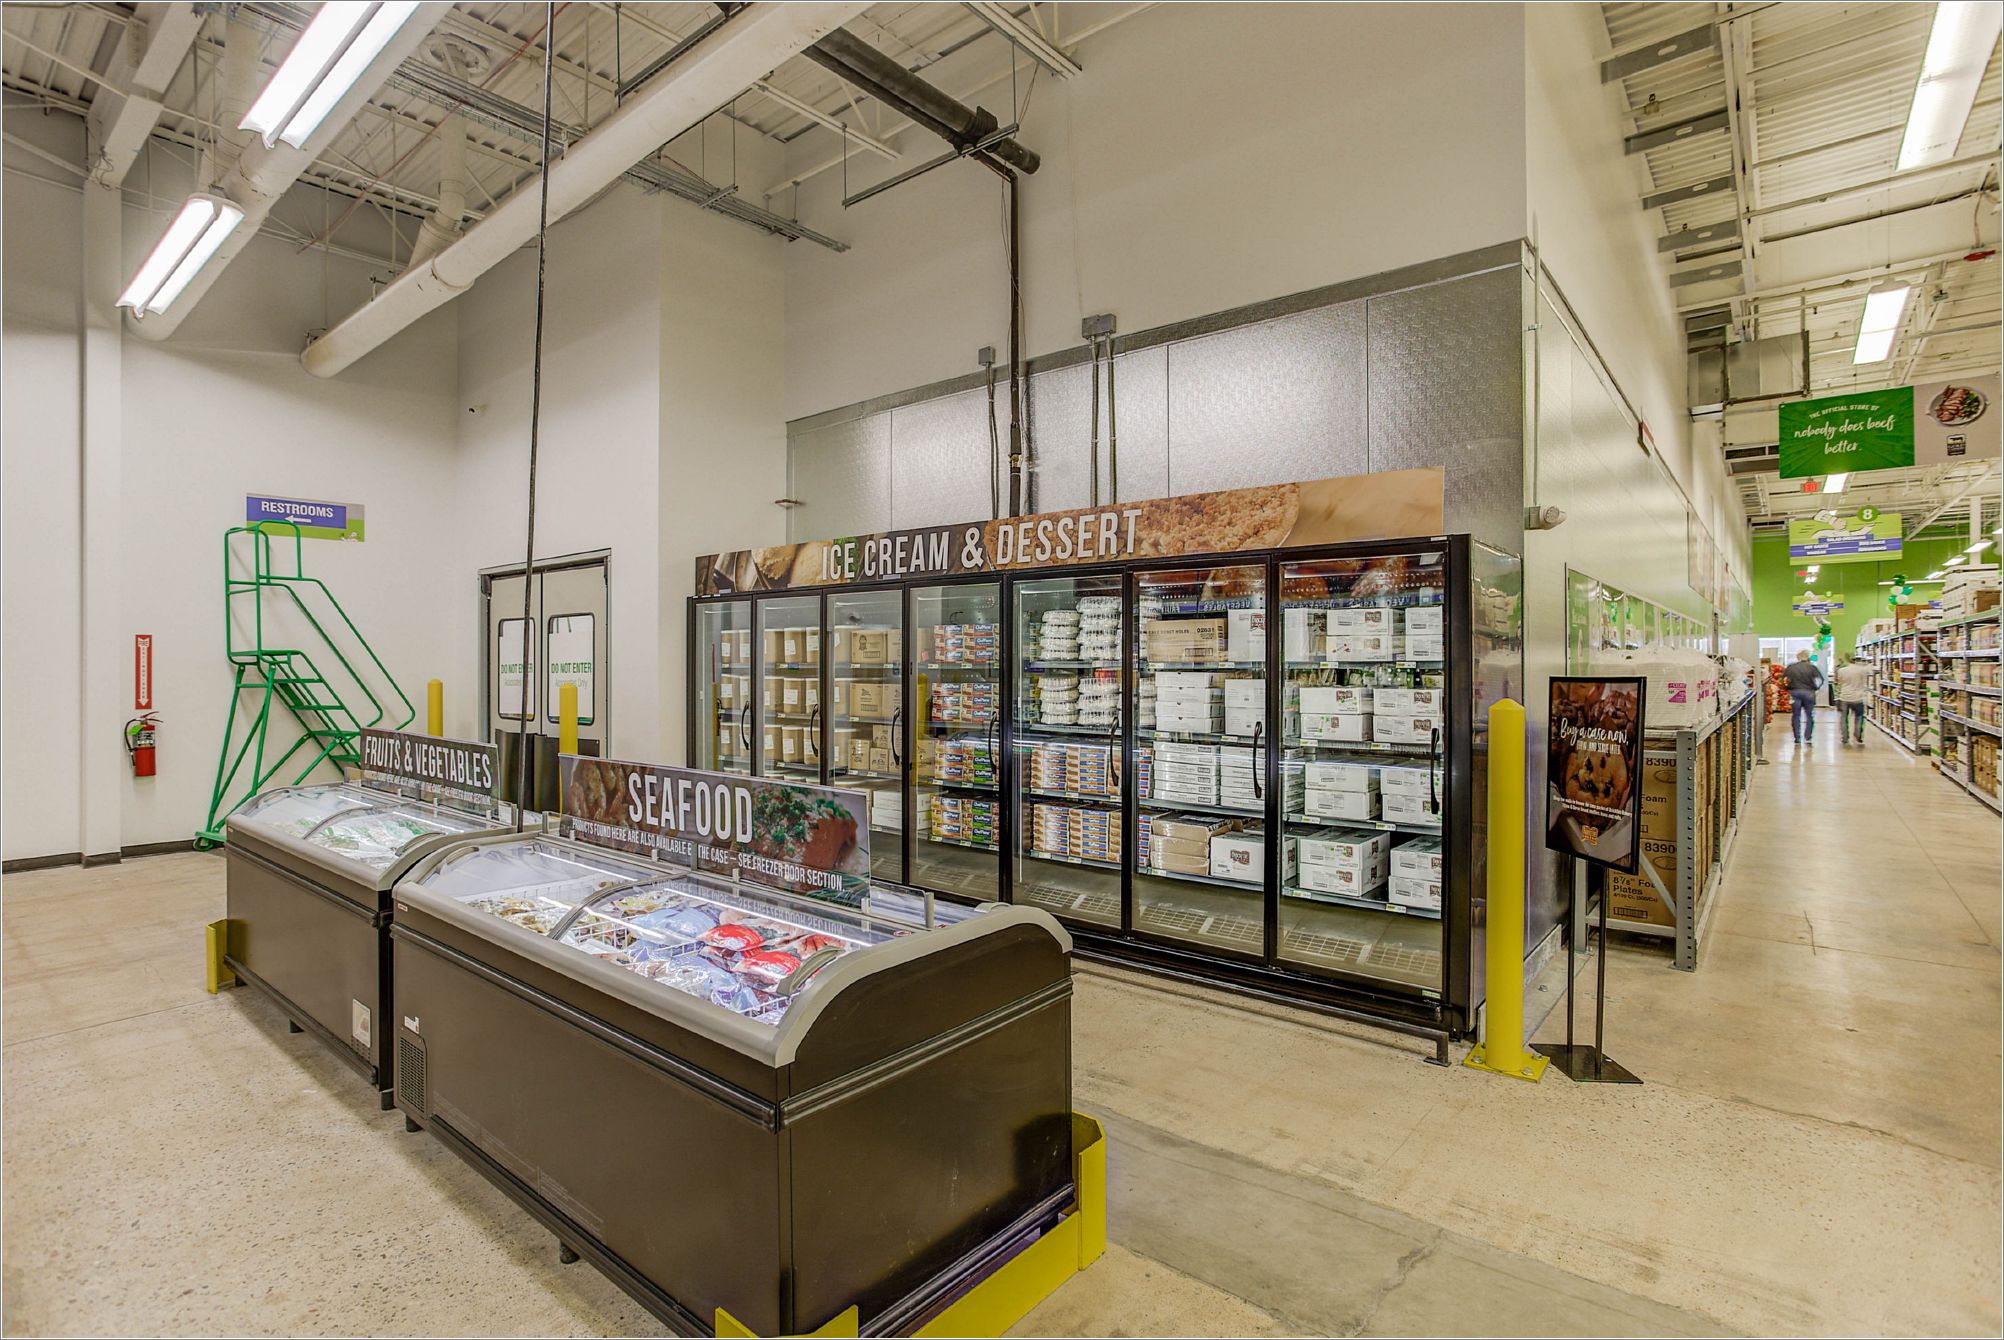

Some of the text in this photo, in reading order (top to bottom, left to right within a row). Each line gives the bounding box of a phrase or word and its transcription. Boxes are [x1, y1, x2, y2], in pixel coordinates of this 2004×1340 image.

[1822, 406, 1848, 414] OFFICIAL
[1794, 414, 1896, 440] nobody does beef
[261, 501, 334, 518] RESTROOMS
[1862, 509, 1872, 520] 8
[821, 508, 1142, 580] ICE CREAM & DESSERT
[551, 662, 592, 674] DO NOT ENTER
[1560, 718, 1578, 746] Buy
[1588, 727, 1607, 740] case
[1608, 730, 1628, 746] now,
[364, 736, 492, 789] FRUITS & VEGETABLES
[628, 772, 752, 844] SEAFOOD
[594, 823, 611, 838] FOUND
[612, 828, 626, 840] HERE
[628, 831, 640, 844] ARE
[640, 834, 656, 848] ALSO
[656, 836, 687, 854] AVAILABLE
[698, 844, 710, 860] THE
[710, 848, 728, 864] CASE
[738, 852, 752, 868] SEE
[753, 857, 784, 876] FREEZER
[784, 864, 806, 882] DOOR
[807, 868, 845, 892] SECTION.
[1644, 842, 1676, 853] 8390
[1613, 884, 1643, 896] Plates
